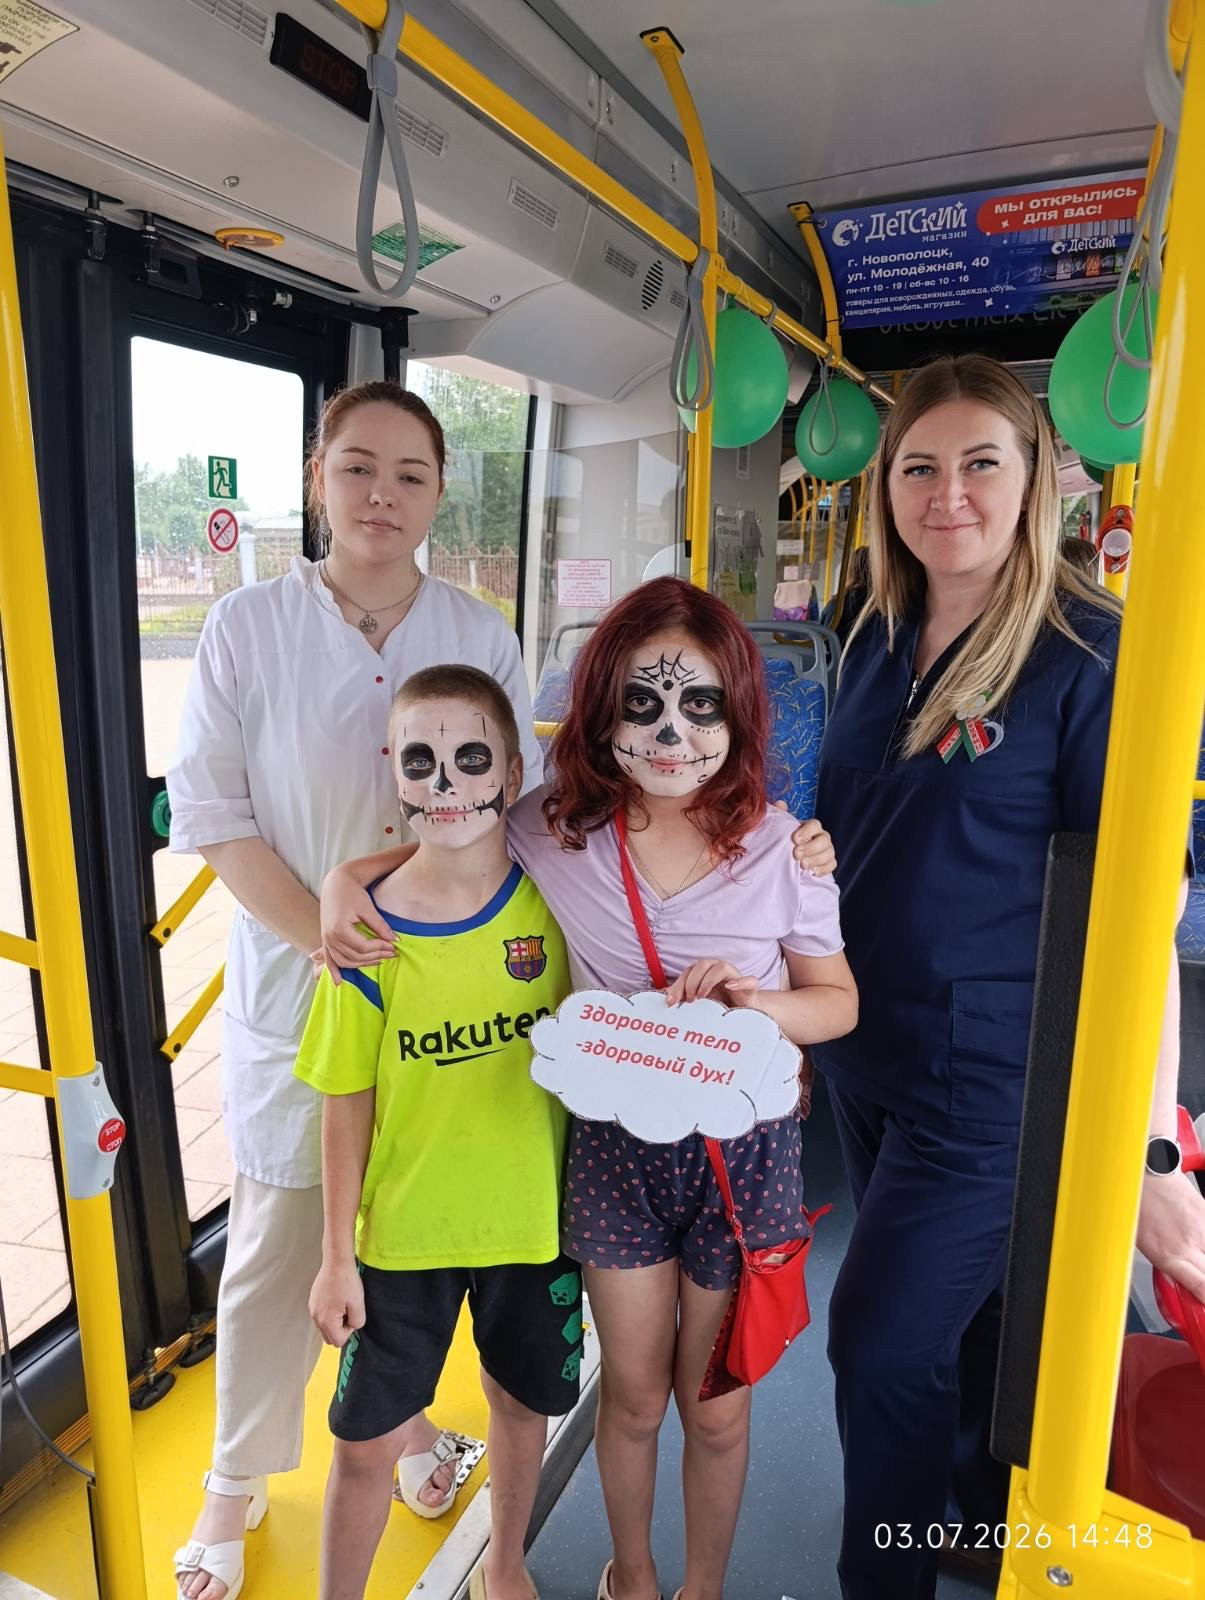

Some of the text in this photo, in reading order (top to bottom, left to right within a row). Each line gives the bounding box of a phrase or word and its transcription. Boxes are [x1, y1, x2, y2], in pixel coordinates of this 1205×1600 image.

[994, 187, 1138, 214] МЫ ОТКРЫЛИСЬ
[1023, 205, 1102, 225] ДЛЯ ВАС!
[922, 231, 968, 243] магазин
[847, 247, 953, 267] г. Новополоцк,
[847, 256, 990, 284] ул. Молодёжная, 40
[873, 284, 883, 292] 10
[939, 277, 949, 285] 10
[579, 1003, 742, 1053] Здоровое тело
[689, 1061, 736, 1085] дух!
[105, 1122, 121, 1136] STOP
[106, 1136, 123, 1151] СТОП
